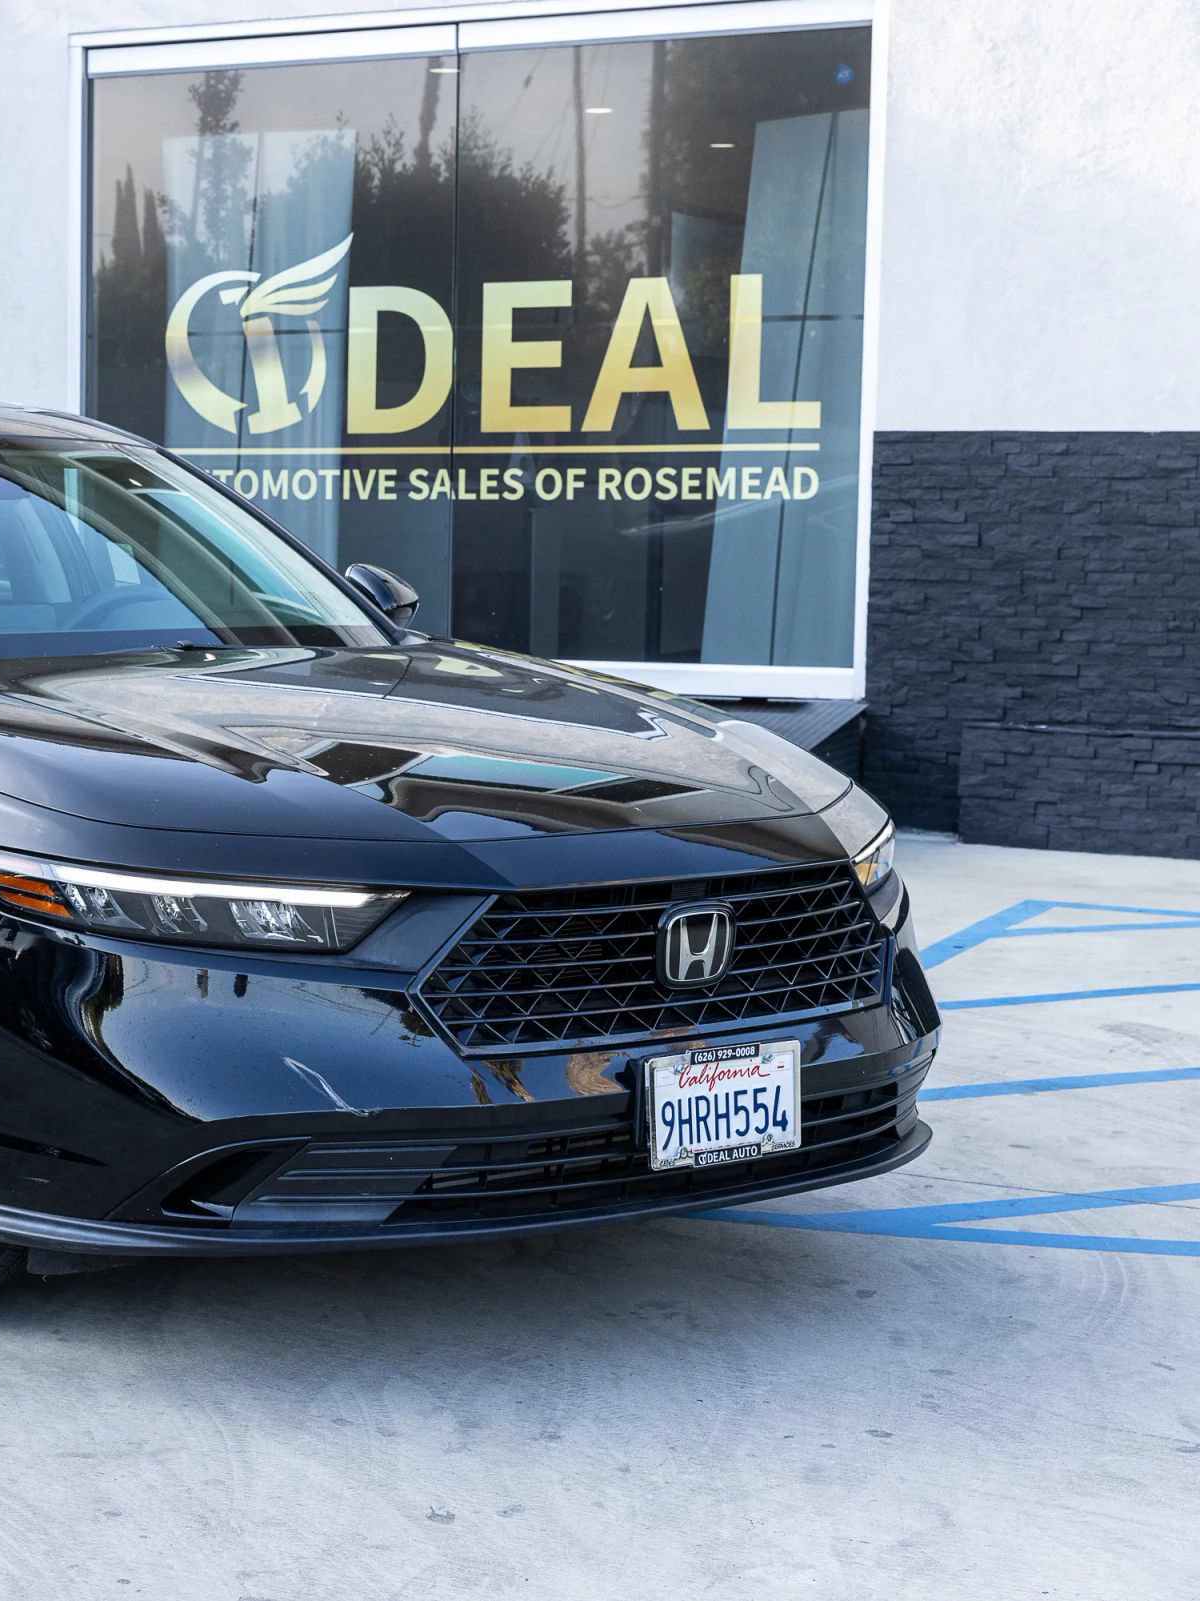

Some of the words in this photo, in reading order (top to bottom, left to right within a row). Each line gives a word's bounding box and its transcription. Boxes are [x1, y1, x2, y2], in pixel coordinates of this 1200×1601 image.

[204, 468, 398, 500] TOMOTIVE
[408, 468, 524, 501] SALES
[534, 468, 586, 500] OF
[598, 466, 820, 501] ROSEMEAD
[694, 1050, 716, 1063] (626)
[717, 1046, 756, 1059] 929-0008
[678, 1059, 770, 1092] California
[661, 1085, 788, 1151] 9HRH554
[732, 1145, 758, 1160] AUTO
